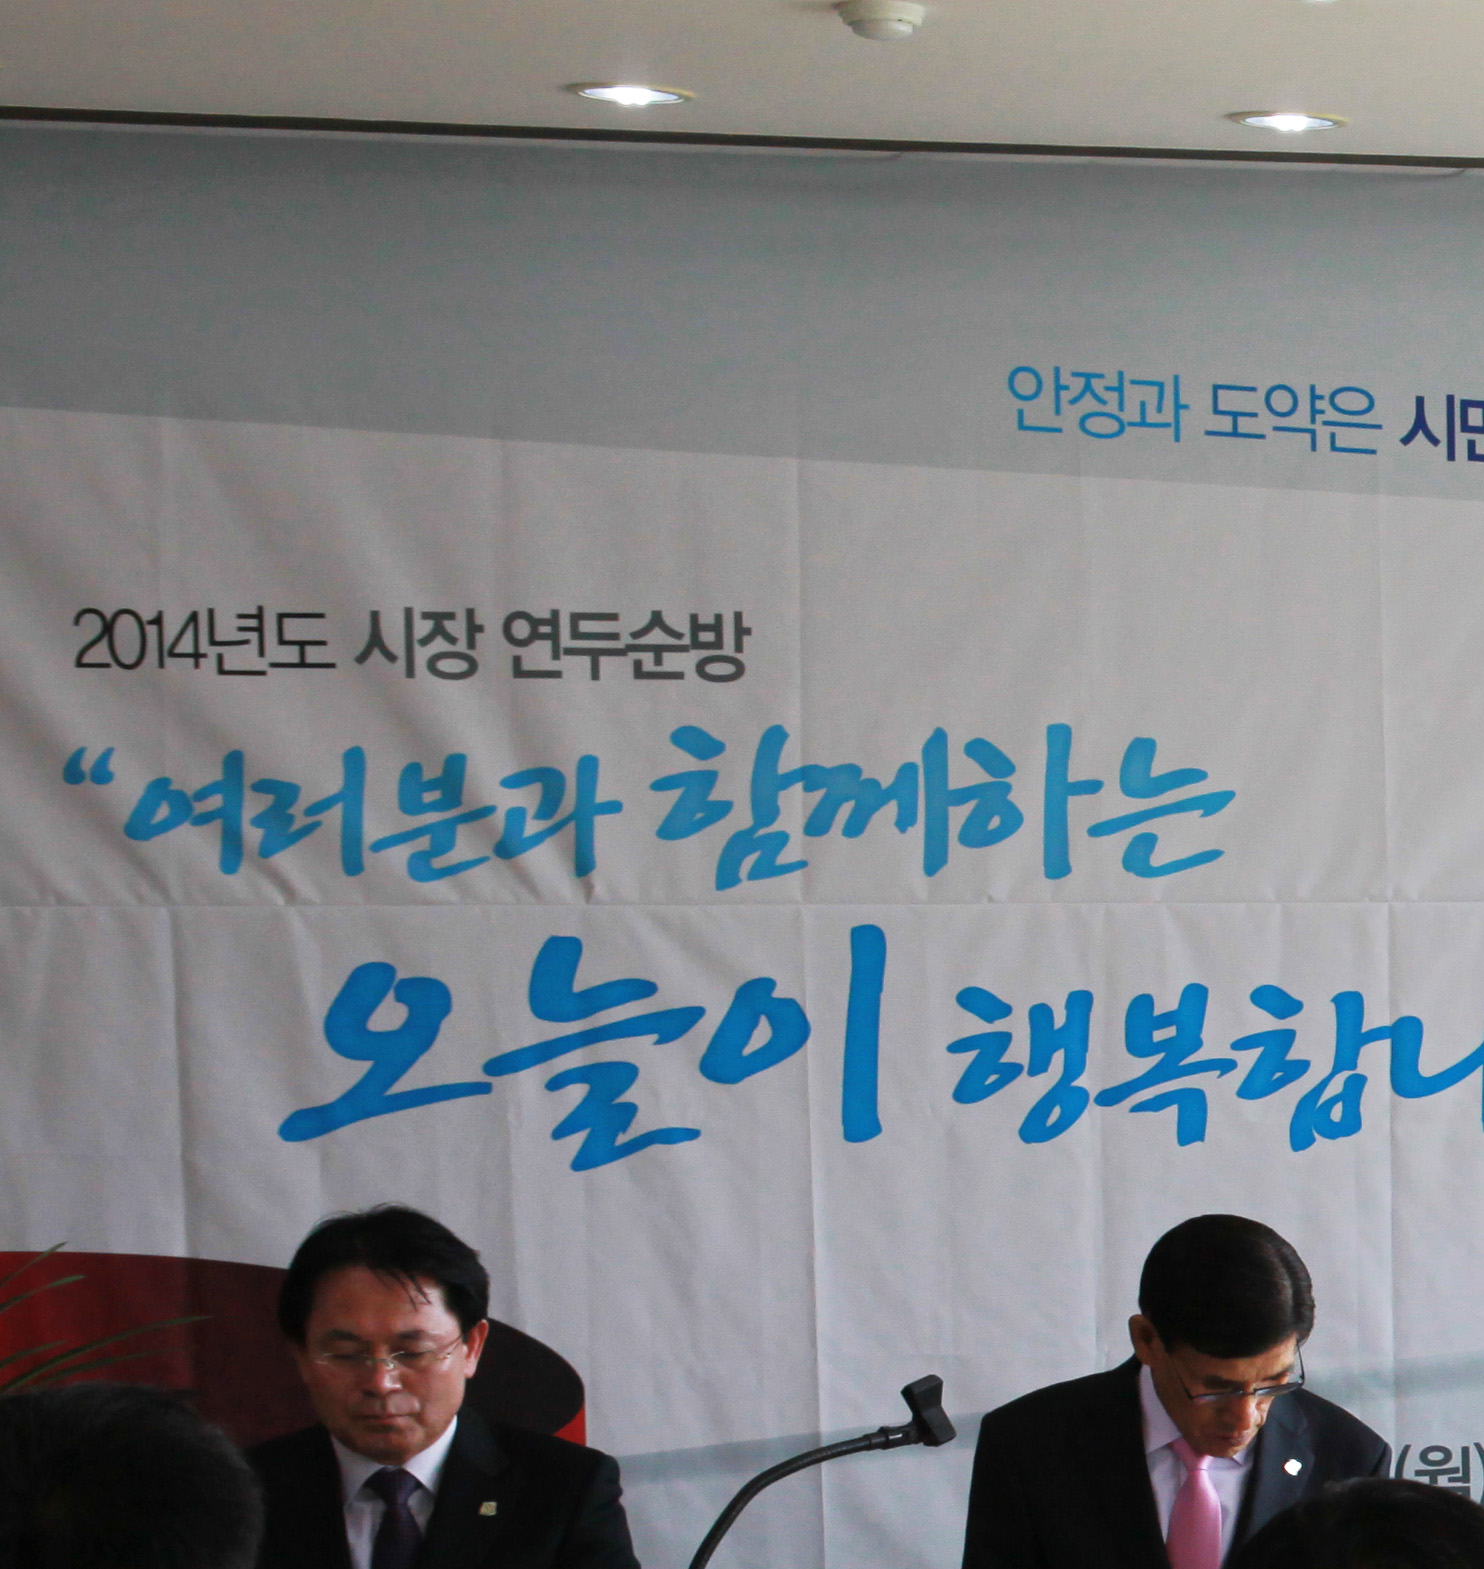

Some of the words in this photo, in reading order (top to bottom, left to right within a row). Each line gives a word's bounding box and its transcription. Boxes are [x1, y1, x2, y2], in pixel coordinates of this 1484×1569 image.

[1006, 365, 1190, 444] 안정과
[1204, 384, 1384, 456] 도약은
[73, 604, 338, 679] 2014년도
[354, 608, 485, 682] 시장
[502, 609, 753, 684] 연두순방
[650, 723, 1238, 892] 함께하는
[278, 924, 888, 1173] 오늘이
